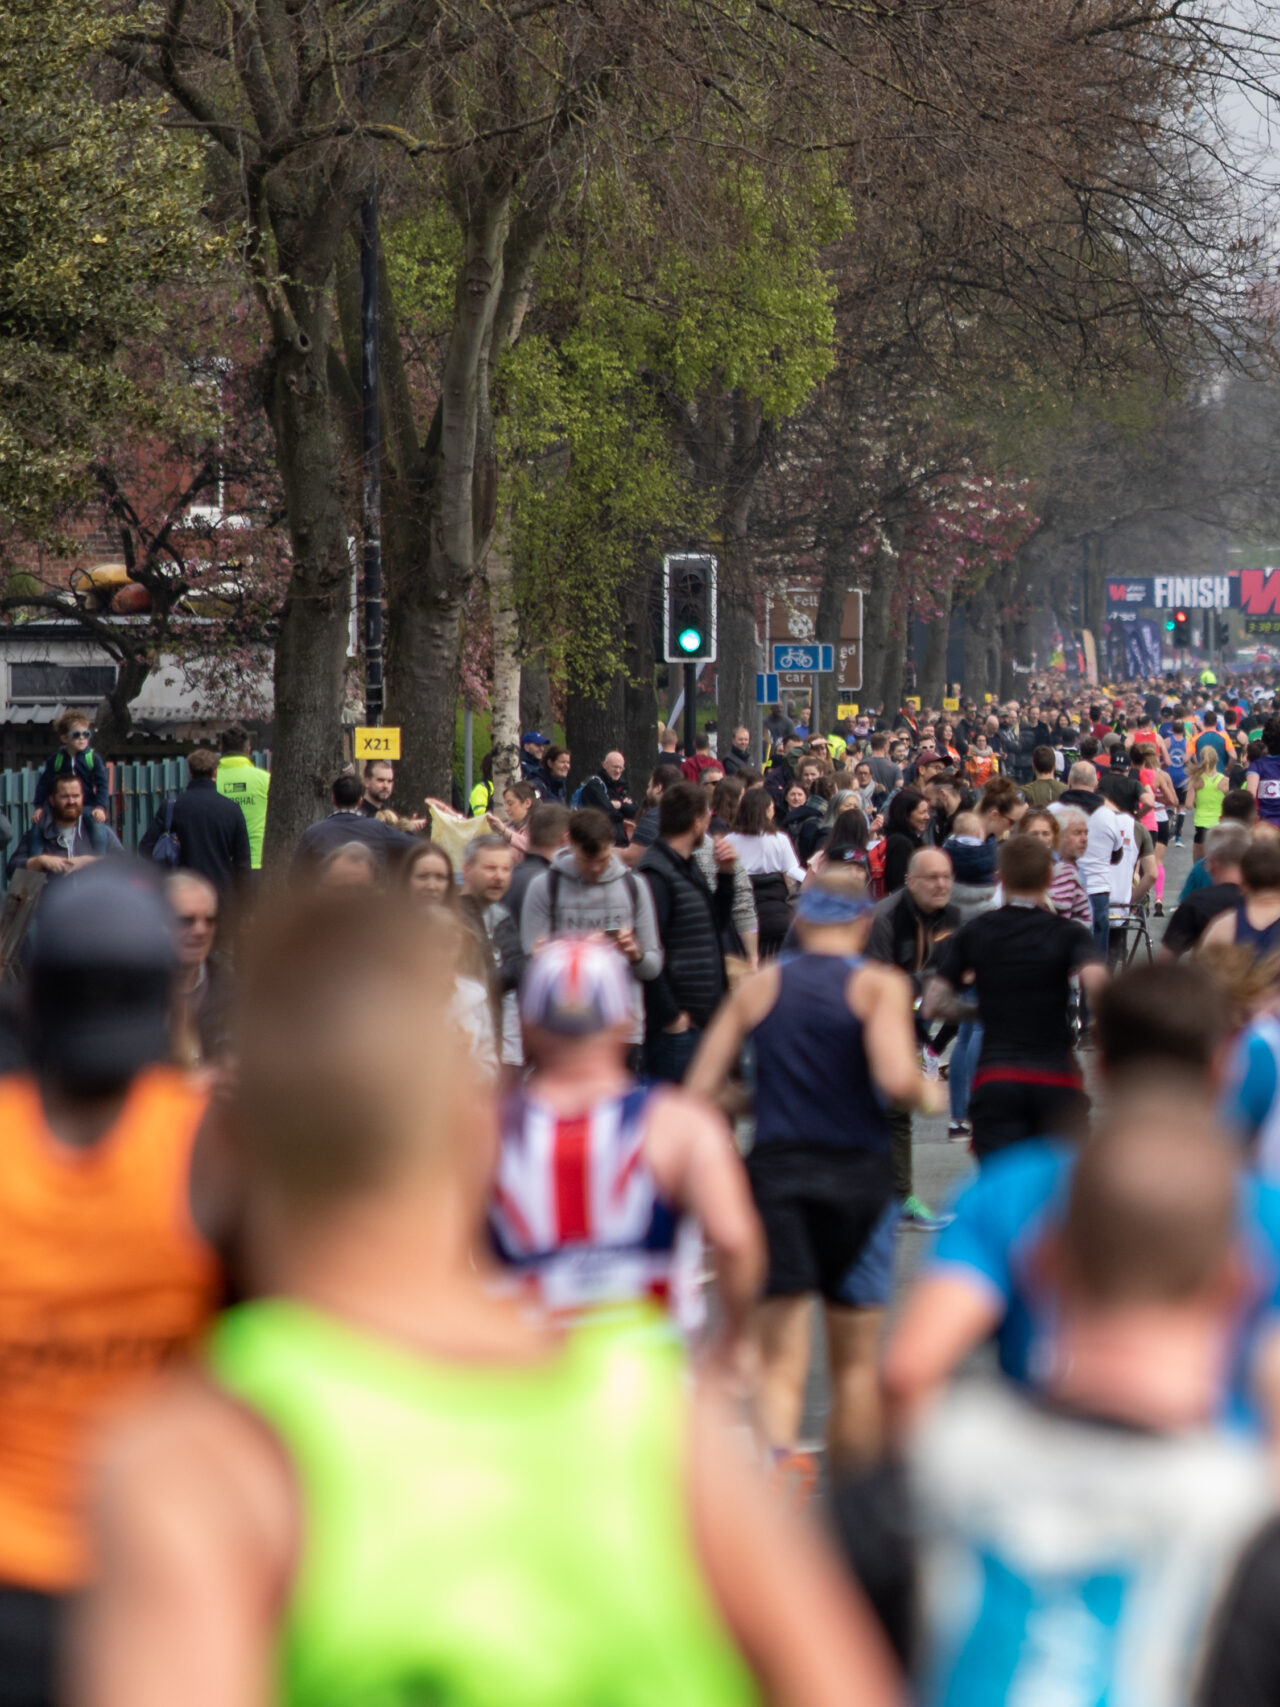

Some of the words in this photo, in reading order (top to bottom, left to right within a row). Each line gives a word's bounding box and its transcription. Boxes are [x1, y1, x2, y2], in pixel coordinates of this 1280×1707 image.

[1155, 575, 1230, 608] FINISH
[786, 674, 806, 683] car
[364, 738, 391, 751] X21
